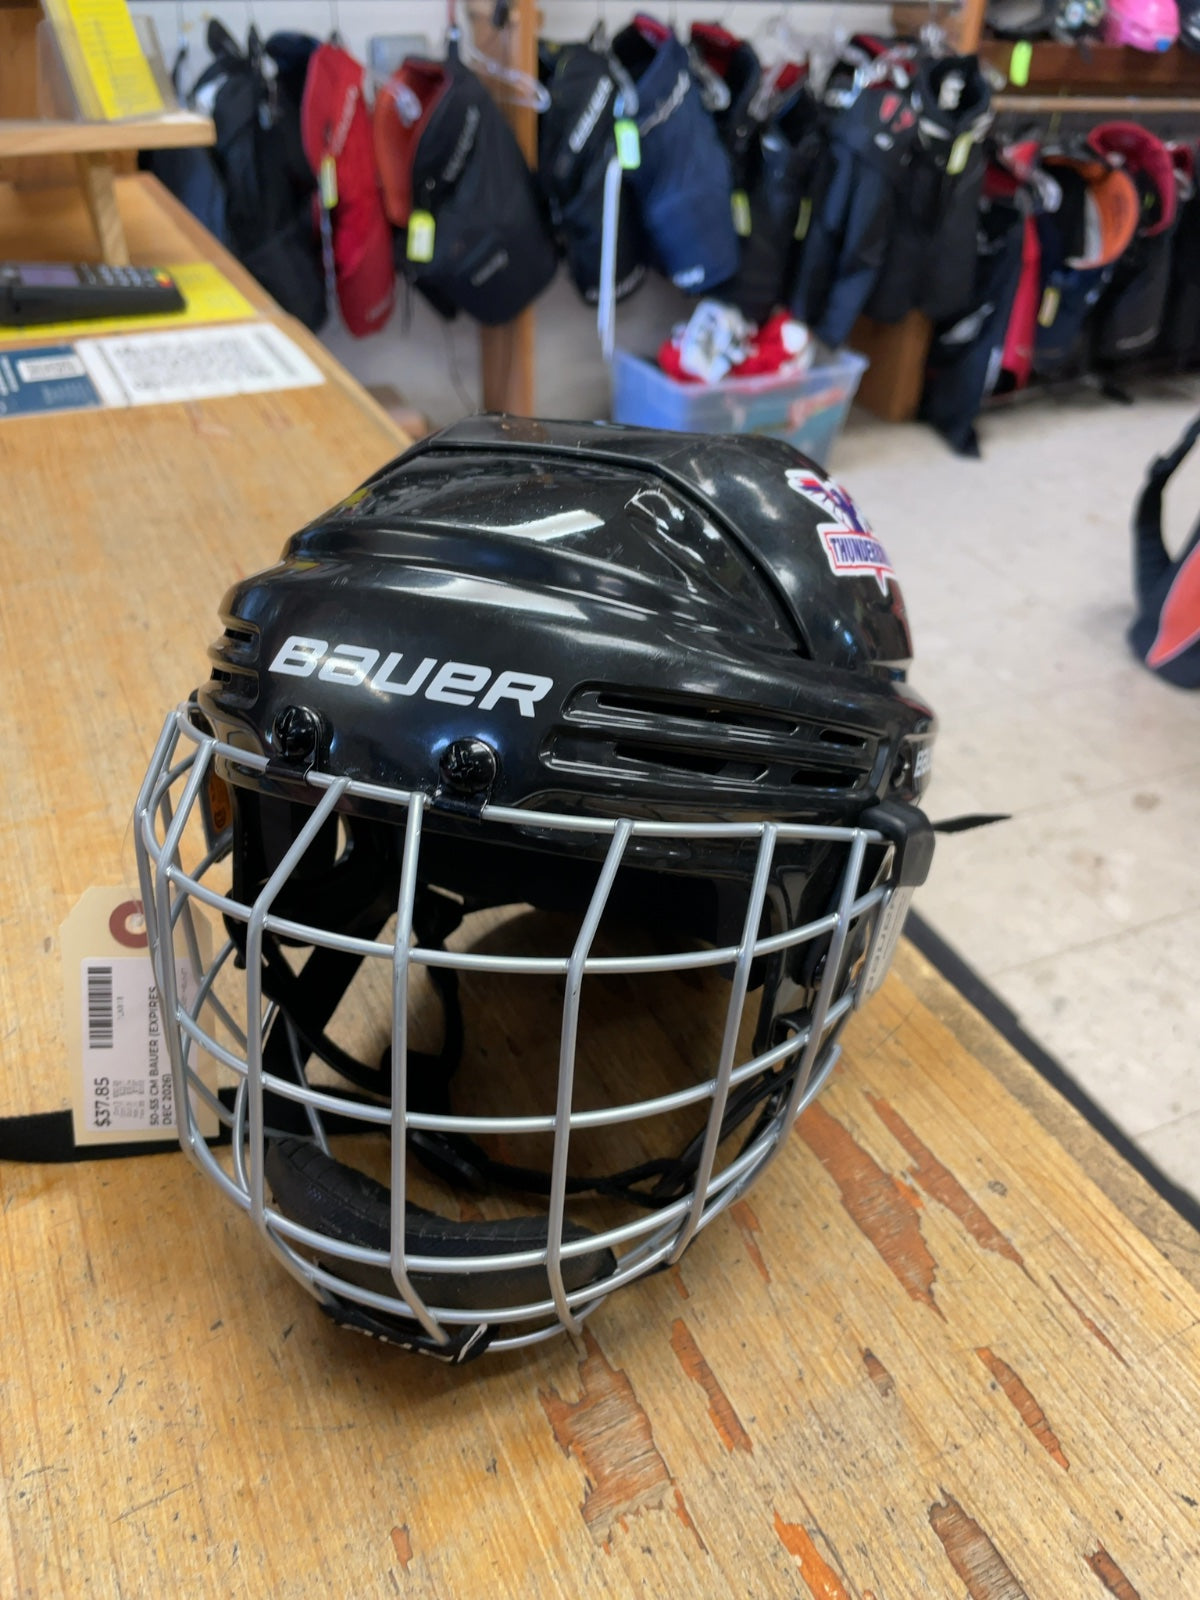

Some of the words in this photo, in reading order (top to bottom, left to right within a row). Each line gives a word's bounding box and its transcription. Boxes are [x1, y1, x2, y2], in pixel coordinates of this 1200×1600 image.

[148, 986, 161, 1037] (EXPIRES
[148, 1040, 160, 1077] BAUER
[93, 1077, 112, 1127] $37.85
[149, 1079, 160, 1096] CM
[162, 1074, 173, 1101] 2026)
[162, 1104, 173, 1126] DEC
